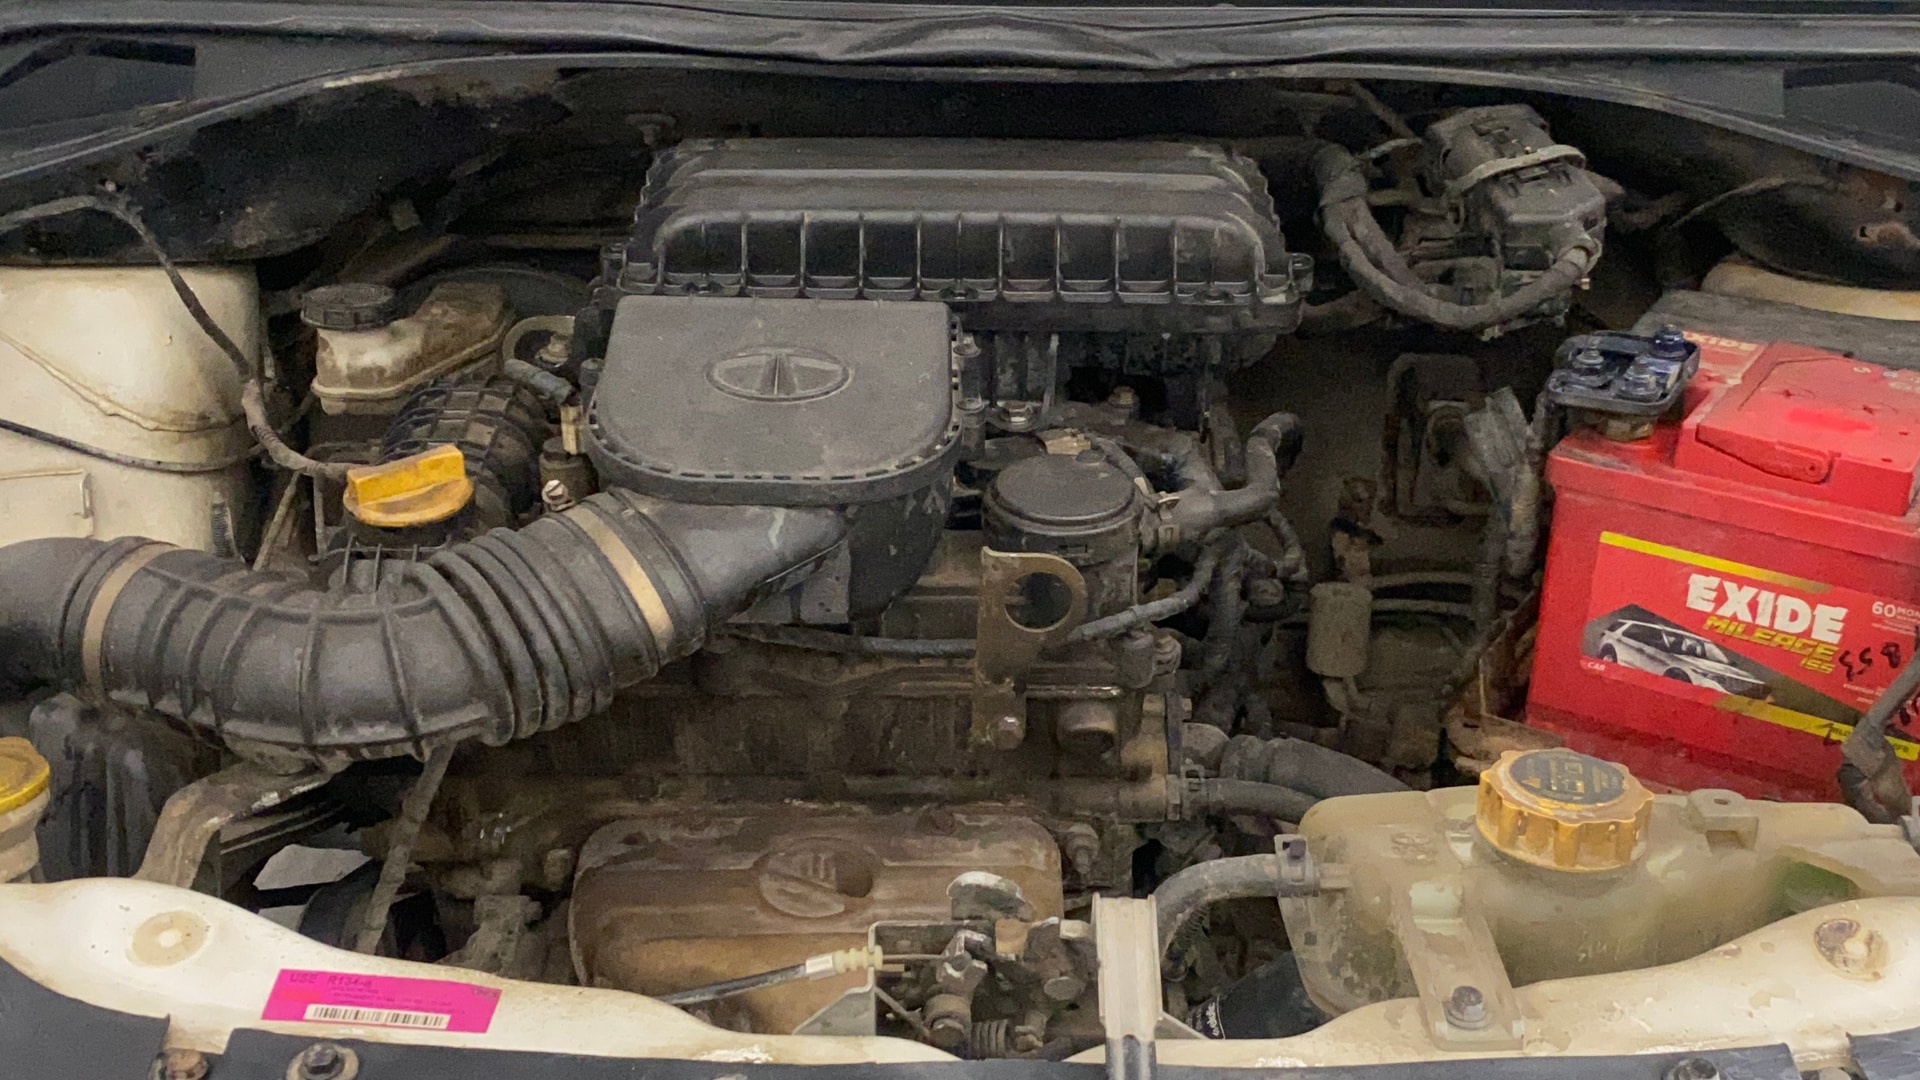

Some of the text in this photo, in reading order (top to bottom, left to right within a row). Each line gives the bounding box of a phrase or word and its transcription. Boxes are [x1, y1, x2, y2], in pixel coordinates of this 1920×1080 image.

[1686, 573, 1848, 644] EXIDE
[1872, 601, 1896, 617] 60
[1703, 616, 1839, 662] MILEAGE
[289, 972, 319, 984] USE
